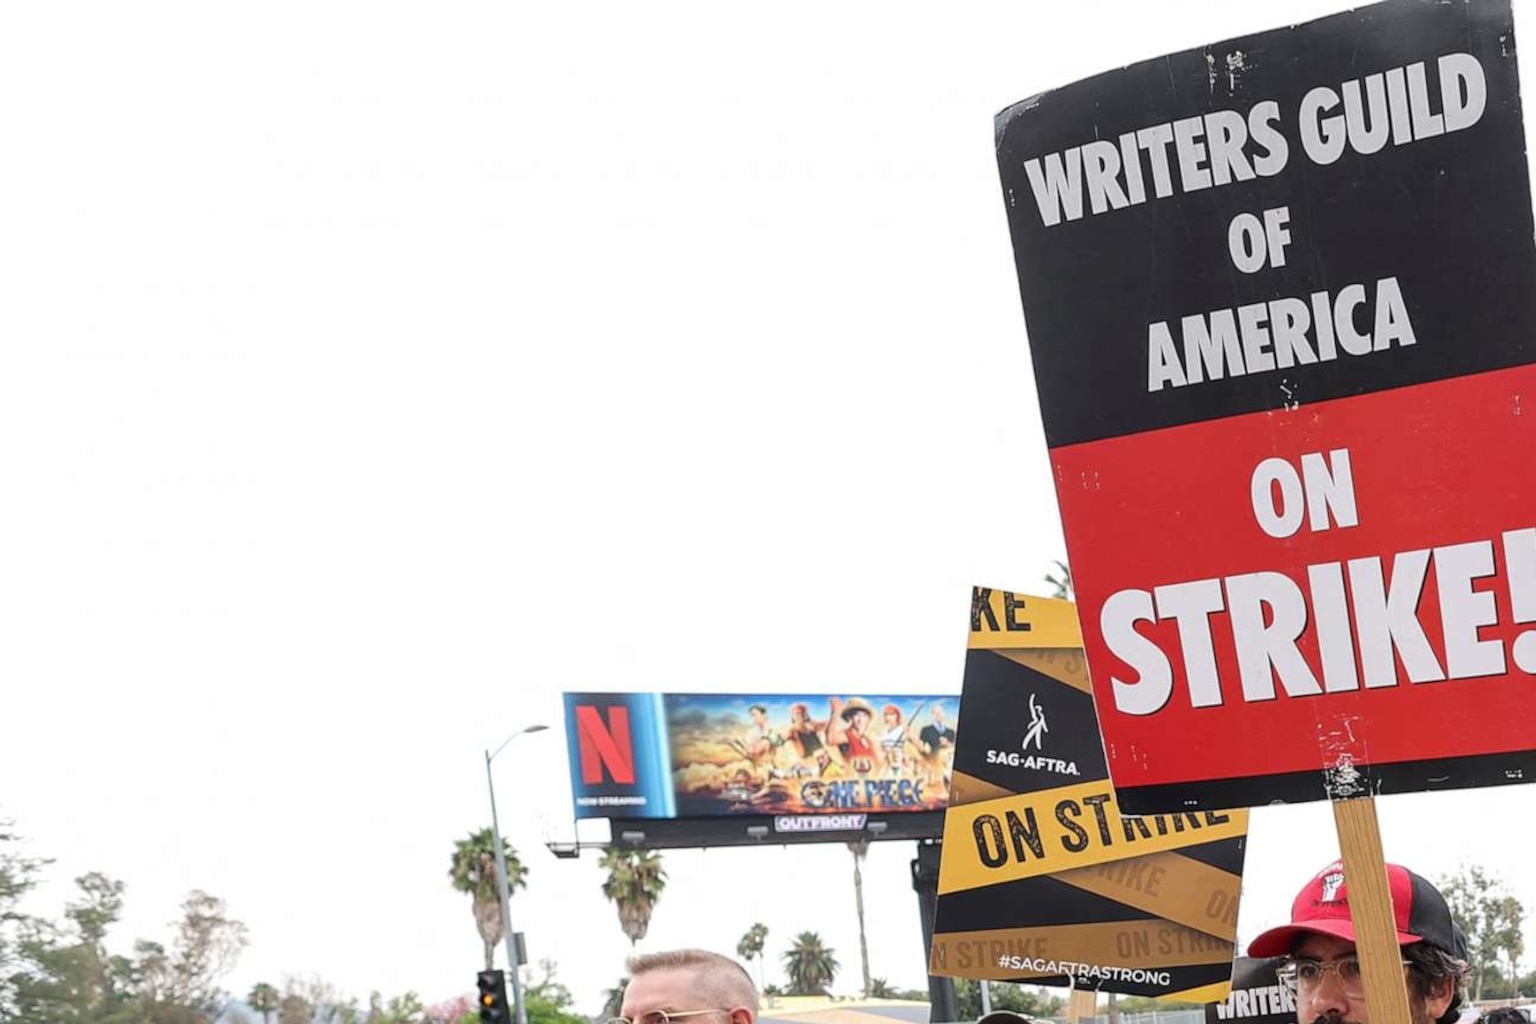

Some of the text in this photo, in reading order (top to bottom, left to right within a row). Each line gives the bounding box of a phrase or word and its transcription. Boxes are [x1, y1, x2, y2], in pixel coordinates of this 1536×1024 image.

[1024, 52, 1487, 227] WRITERS GUILD
[1228, 206, 1292, 274] OF
[1147, 276, 1416, 393] AMERICA
[1250, 448, 1358, 539] ON
[779, 816, 862, 829] OUTFRONT
[972, 806, 1045, 868] ON
[998, 955, 1171, 986] #SAGAFTRASTRONG
[1216, 984, 1297, 1020] WRITER
